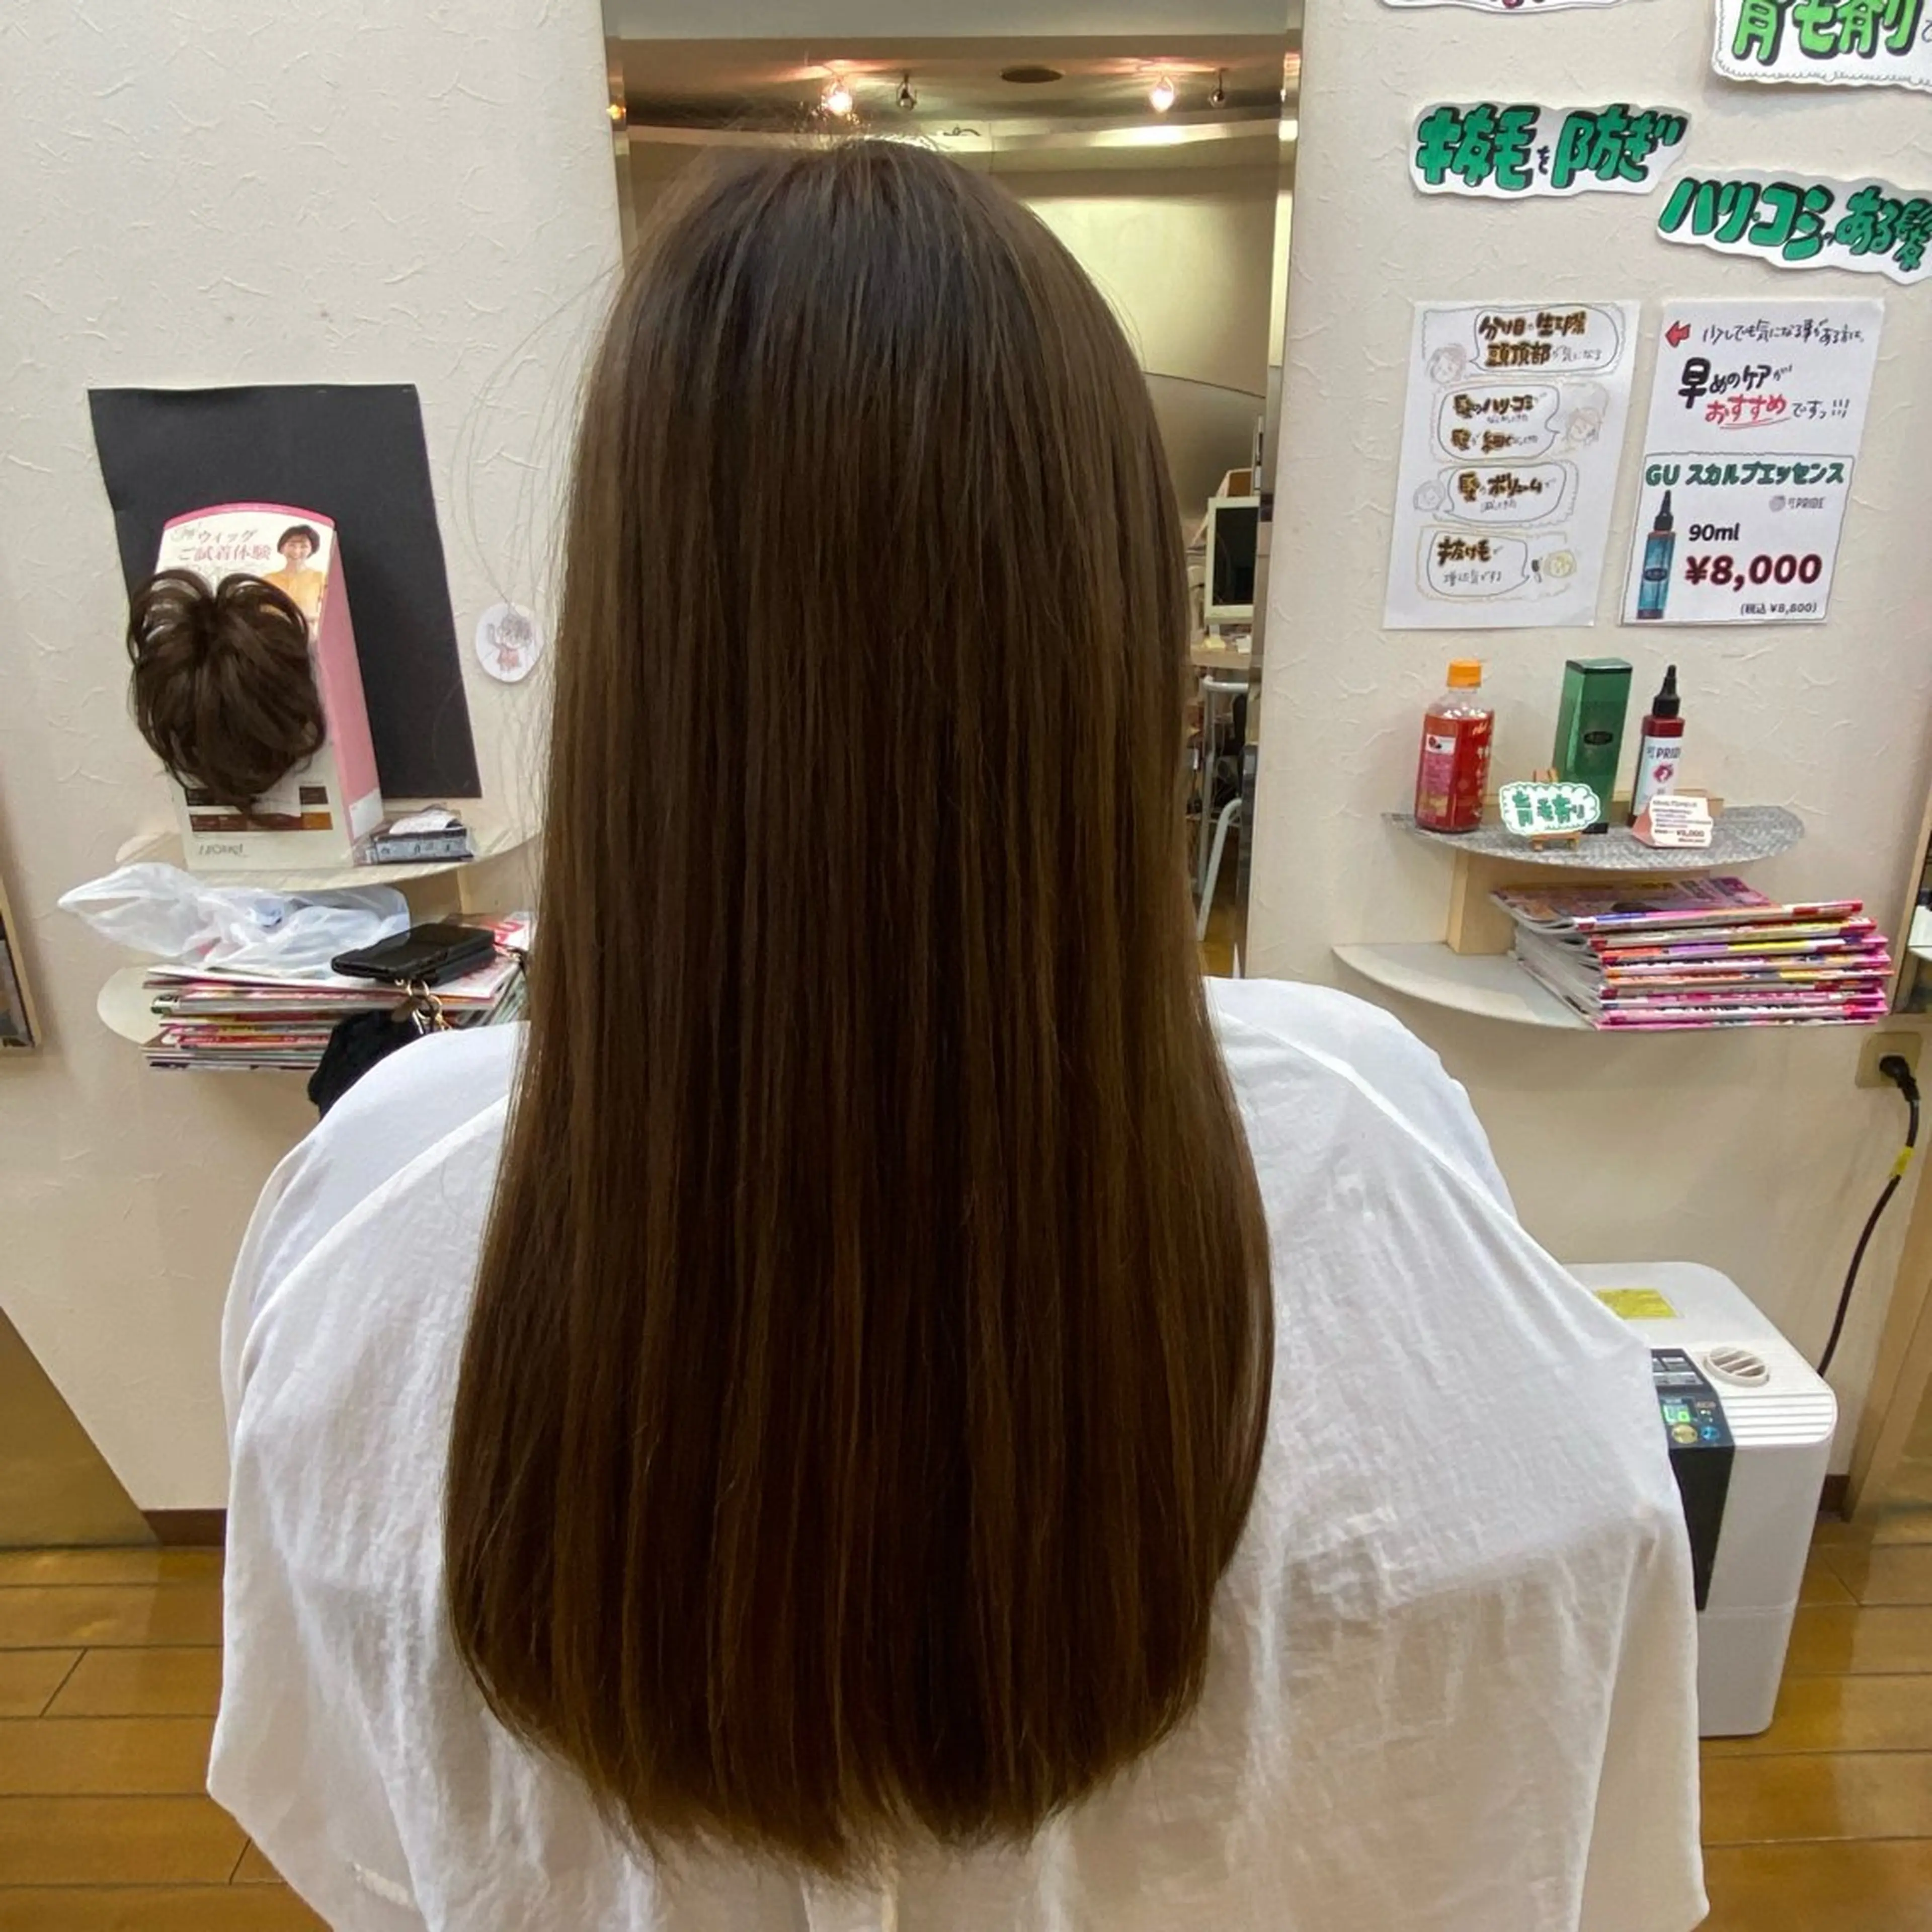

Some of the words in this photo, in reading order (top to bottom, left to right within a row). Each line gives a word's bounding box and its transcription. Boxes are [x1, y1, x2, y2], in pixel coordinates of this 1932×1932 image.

[1678, 357, 1793, 409] 早めのケアが
[1646, 464, 1680, 486] GU
[1685, 462, 1844, 486] スカルプエッセンス
[1688, 523, 1740, 541] 90ml
[1685, 553, 1822, 592] ¥8,000
[1512, 790, 1584, 827] 育毛剤
